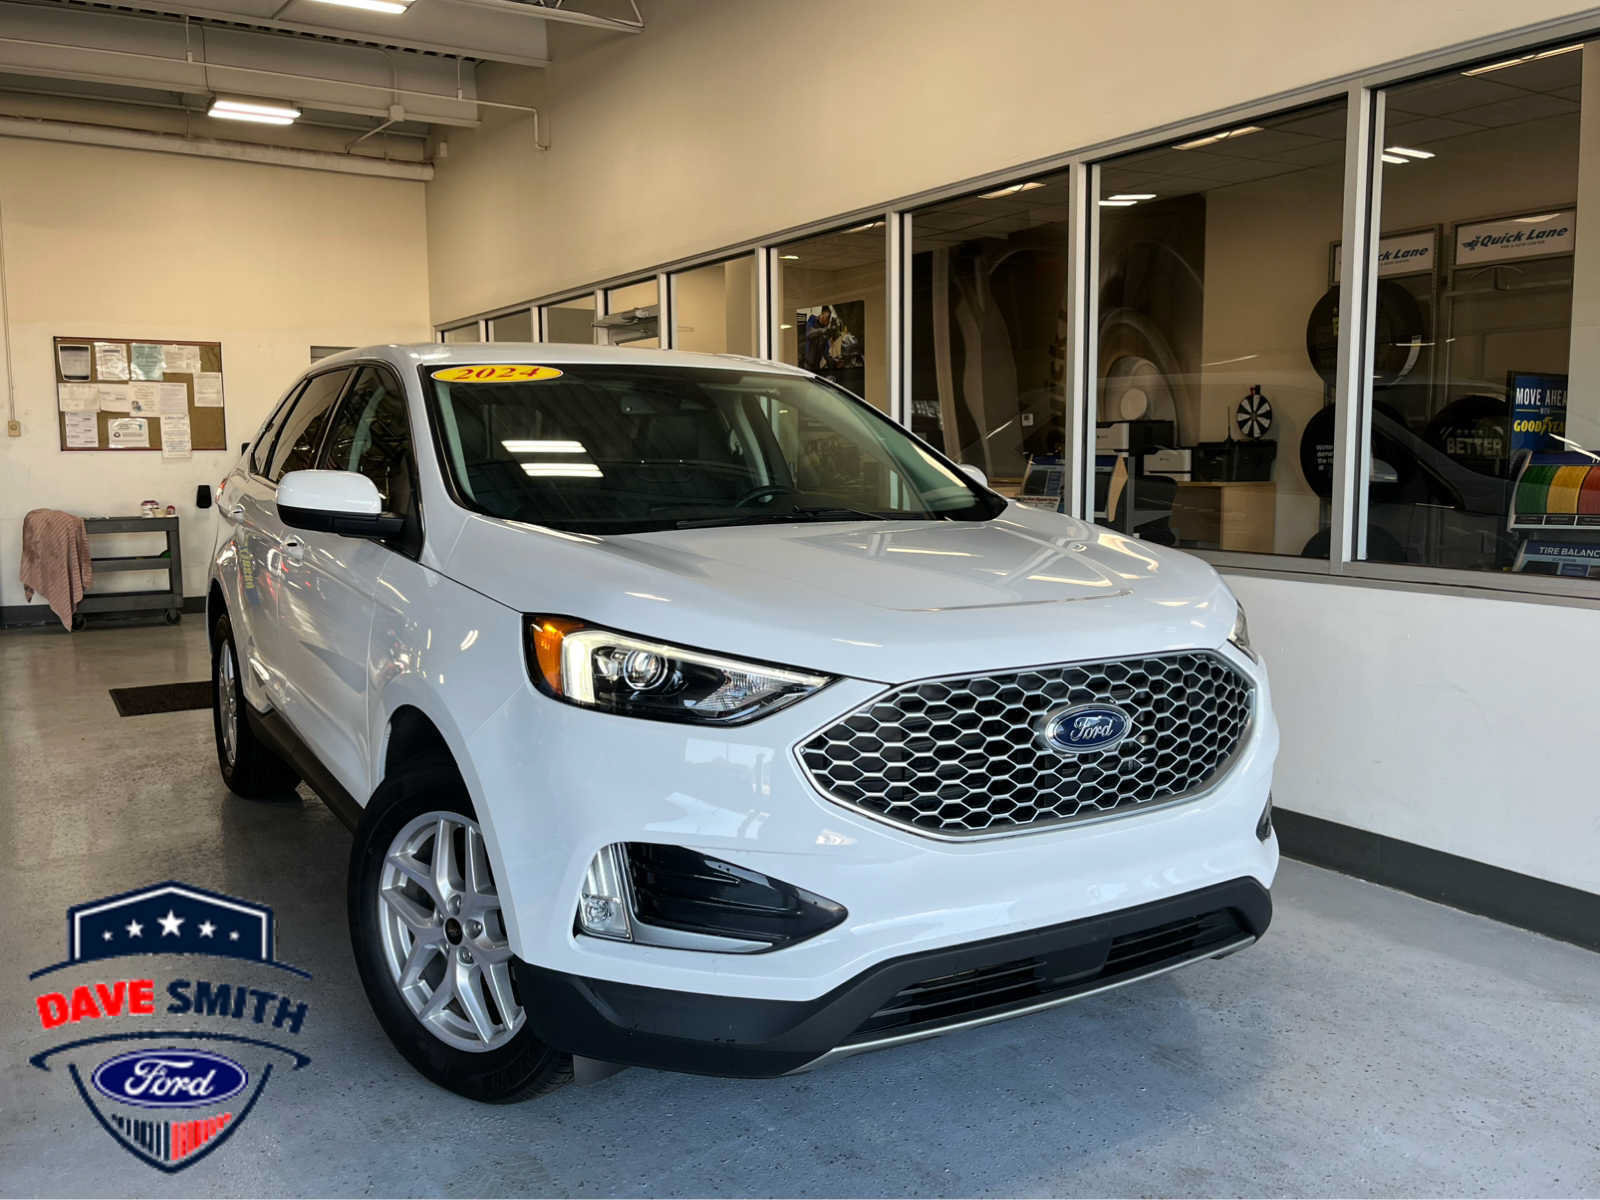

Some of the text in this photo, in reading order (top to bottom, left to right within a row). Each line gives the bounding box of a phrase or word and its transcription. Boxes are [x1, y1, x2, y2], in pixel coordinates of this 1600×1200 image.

[1480, 231, 1524, 247] Quick
[1526, 227, 1568, 241] Lane
[1393, 247, 1428, 259] Lane
[454, 367, 540, 380] 2024
[1515, 387, 1542, 406] MOVE
[1447, 437, 1503, 456] BETTER
[1538, 546, 1560, 555] TIRE
[1070, 715, 1113, 742] Ford
